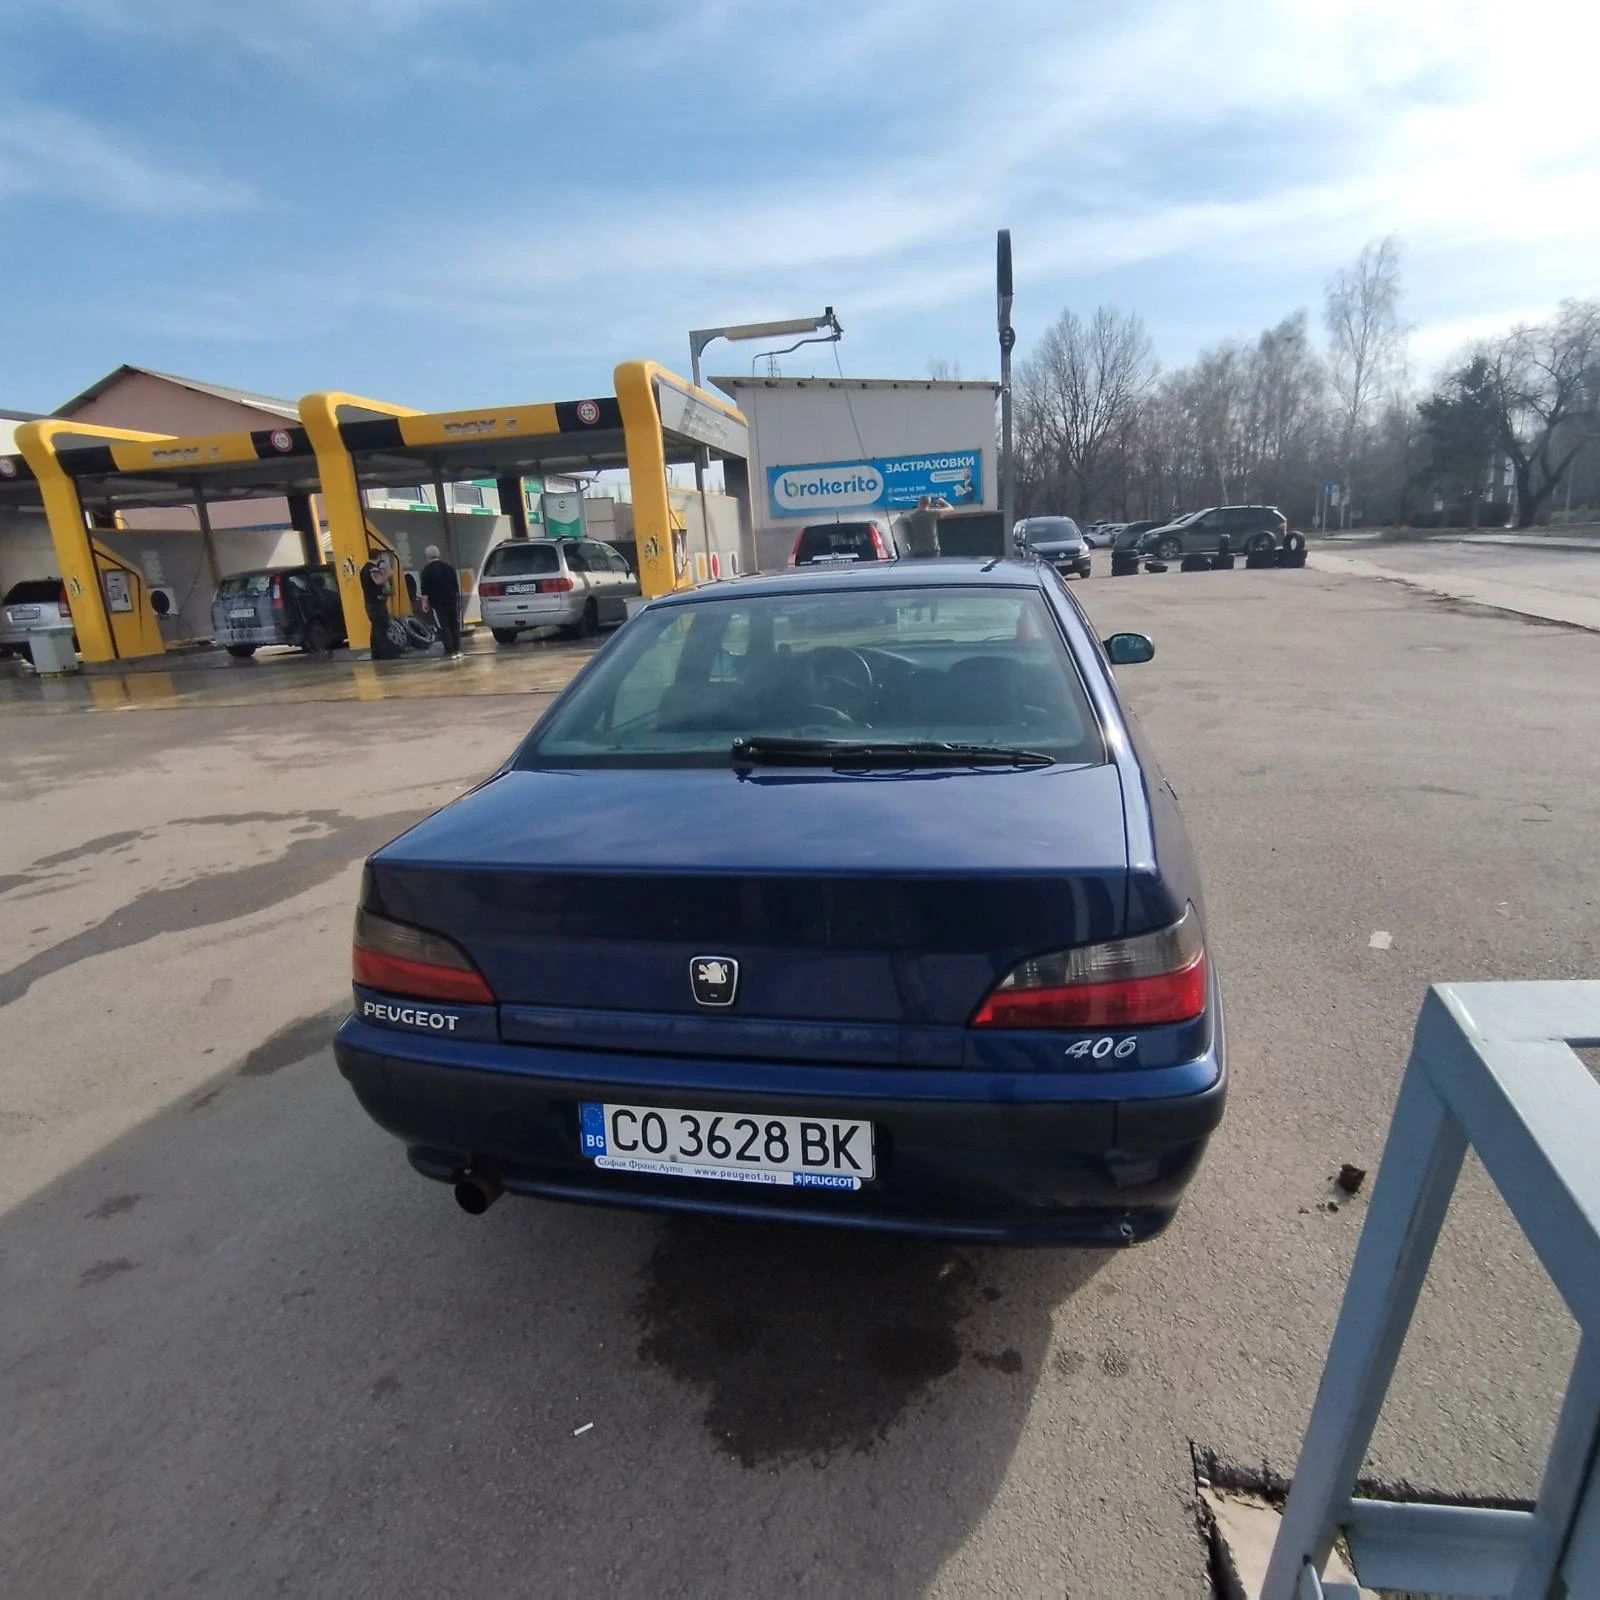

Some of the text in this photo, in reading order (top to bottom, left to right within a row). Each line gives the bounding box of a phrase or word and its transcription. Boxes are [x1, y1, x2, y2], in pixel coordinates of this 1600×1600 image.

[885, 456, 975, 473] ЗАСТРАХОВКИ
[783, 475, 877, 498] brokerito
[363, 1001, 459, 1031] PEUGEOT
[1064, 1036, 1138, 1059] 406
[586, 1134, 604, 1148] BG
[611, 1109, 863, 1170] CO 3628 BK
[694, 1168, 777, 1183] www.peugeot.bg
[805, 1175, 853, 1188] PEUGEOT
